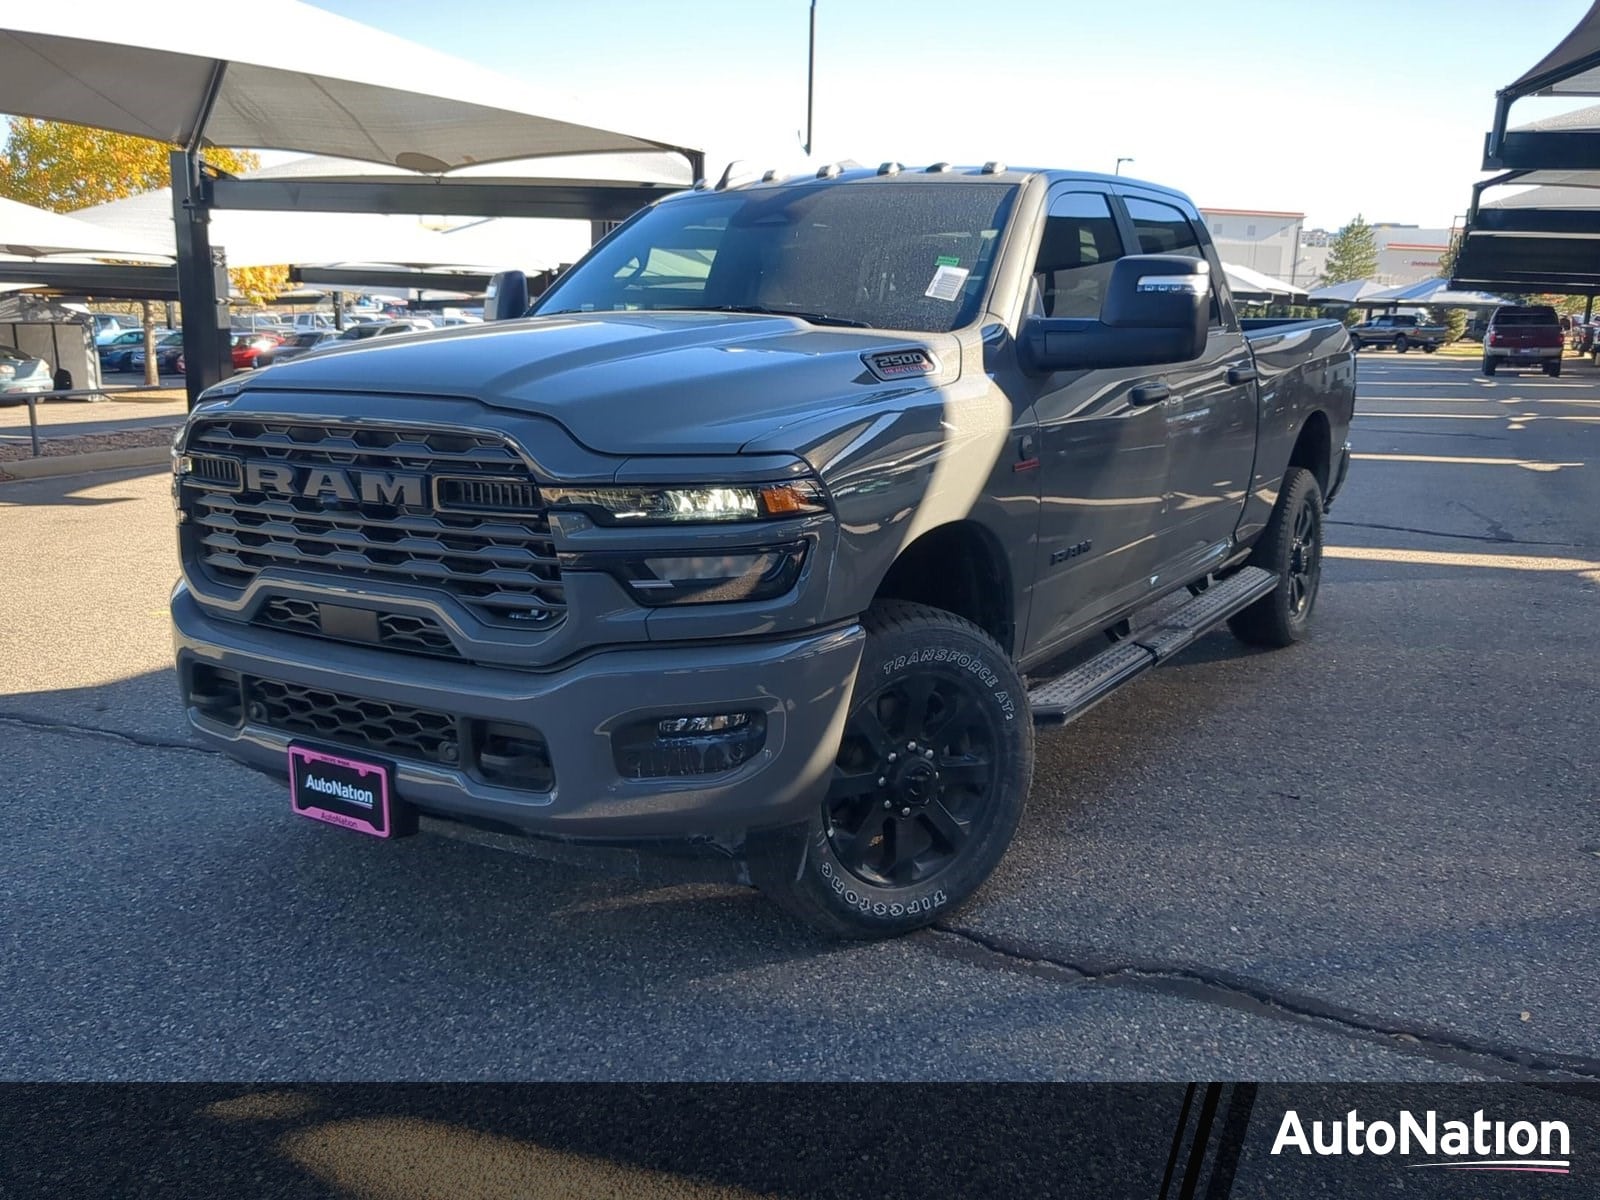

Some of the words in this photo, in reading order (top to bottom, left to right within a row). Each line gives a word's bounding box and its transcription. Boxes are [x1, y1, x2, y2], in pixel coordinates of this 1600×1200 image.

[879, 353, 923, 366] 2500
[247, 463, 425, 507] RAM
[883, 649, 998, 688] TRANSFORCE
[305, 774, 373, 803] AutoNation
